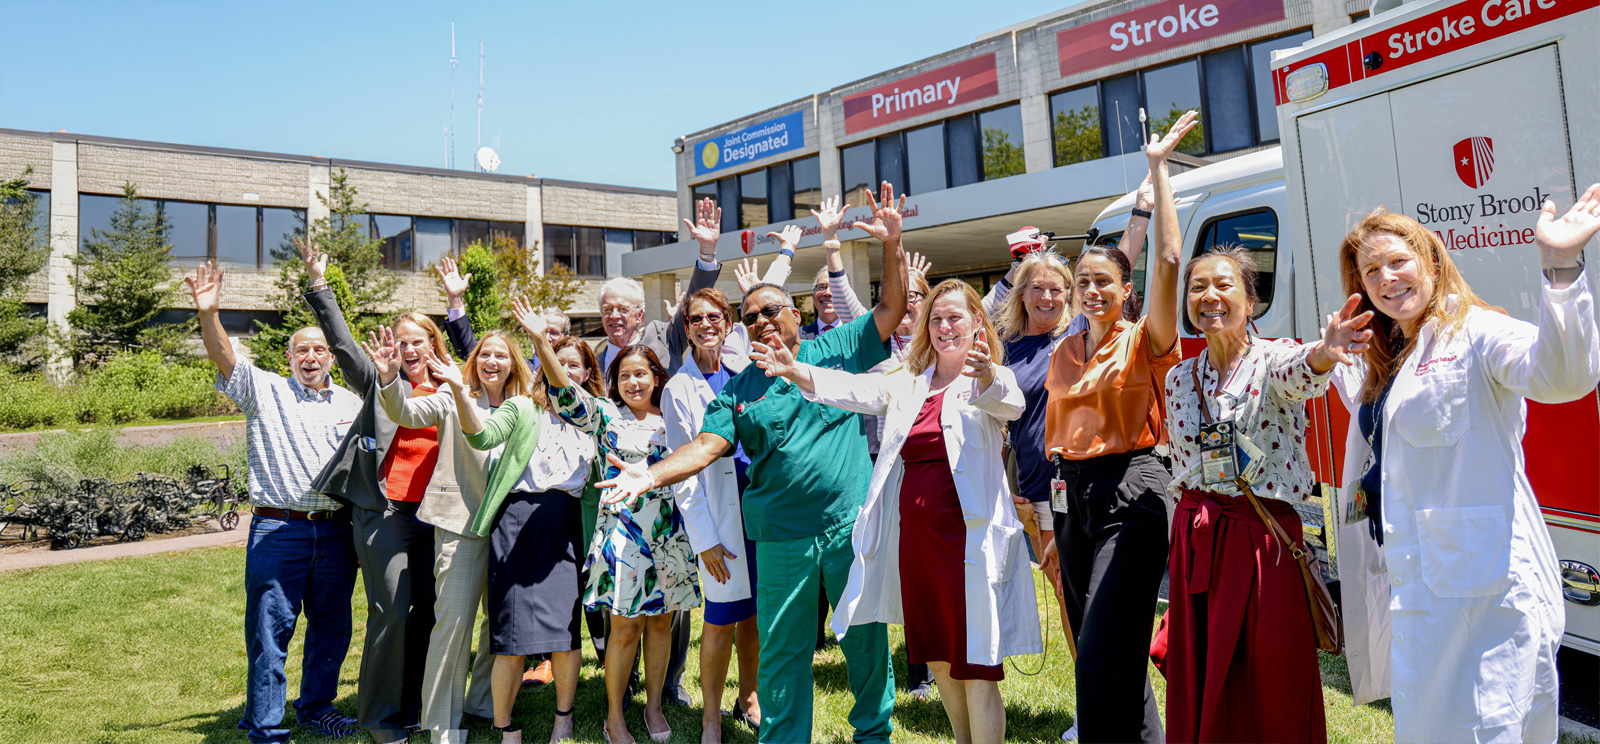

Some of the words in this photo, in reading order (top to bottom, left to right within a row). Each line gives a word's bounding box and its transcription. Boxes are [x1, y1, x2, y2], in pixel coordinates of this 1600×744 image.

[1110, 4, 1219, 51] Stroke
[1388, 15, 1476, 59] Stroke
[871, 76, 961, 118] Primary
[723, 135, 741, 148] Joint
[741, 122, 786, 142] Commission
[723, 131, 789, 163] Designated
[1416, 202, 1475, 225] Stony
[1478, 187, 1551, 218] Brook
[1434, 223, 1535, 251] Medicine
